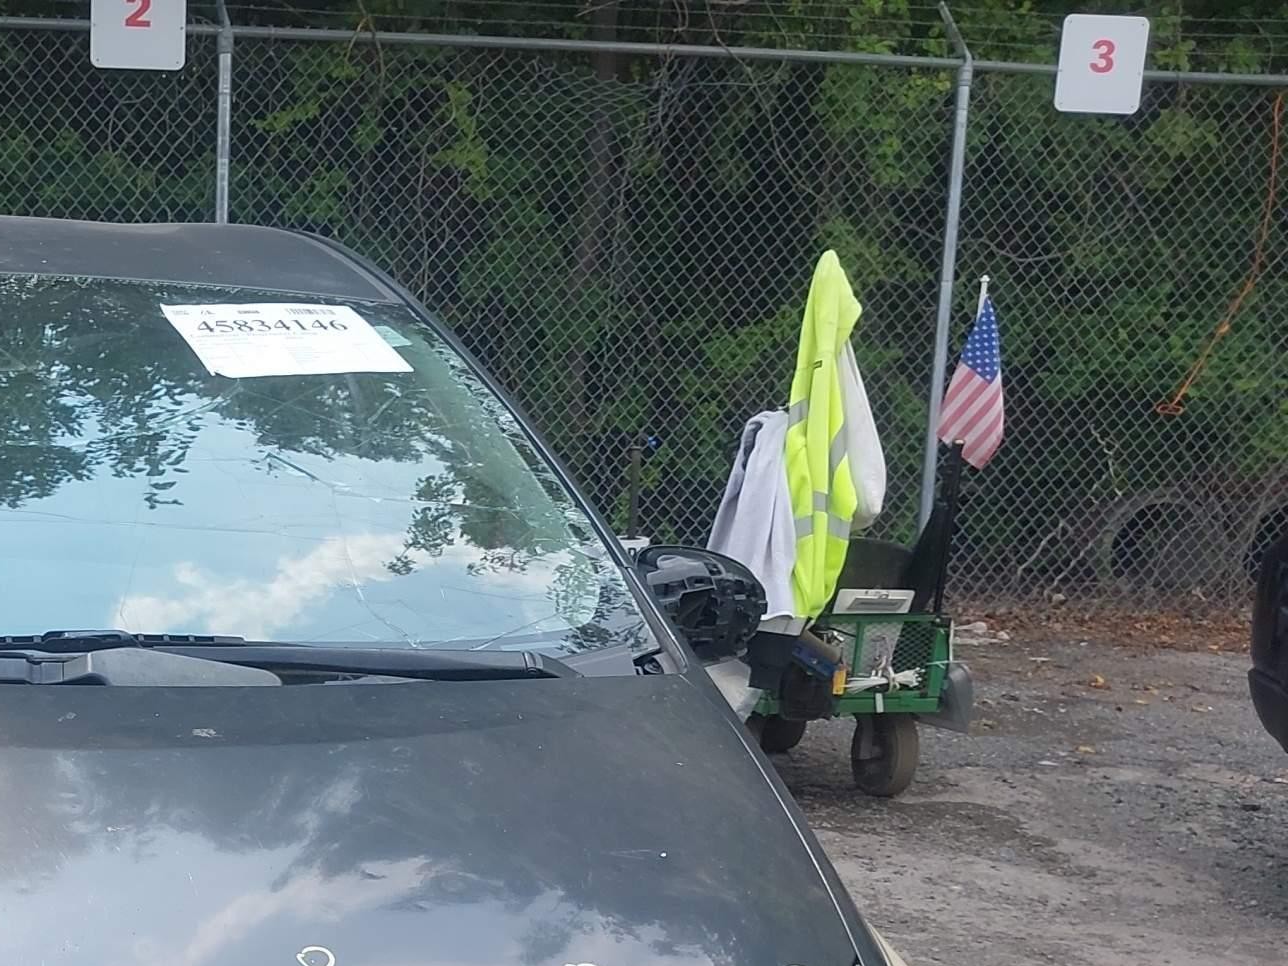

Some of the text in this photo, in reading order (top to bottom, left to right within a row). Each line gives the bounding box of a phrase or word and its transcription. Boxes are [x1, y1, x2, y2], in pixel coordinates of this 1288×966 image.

[124, 0, 152, 28] 2
[1089, 39, 1116, 74] 3
[197, 318, 349, 333] 45834146
